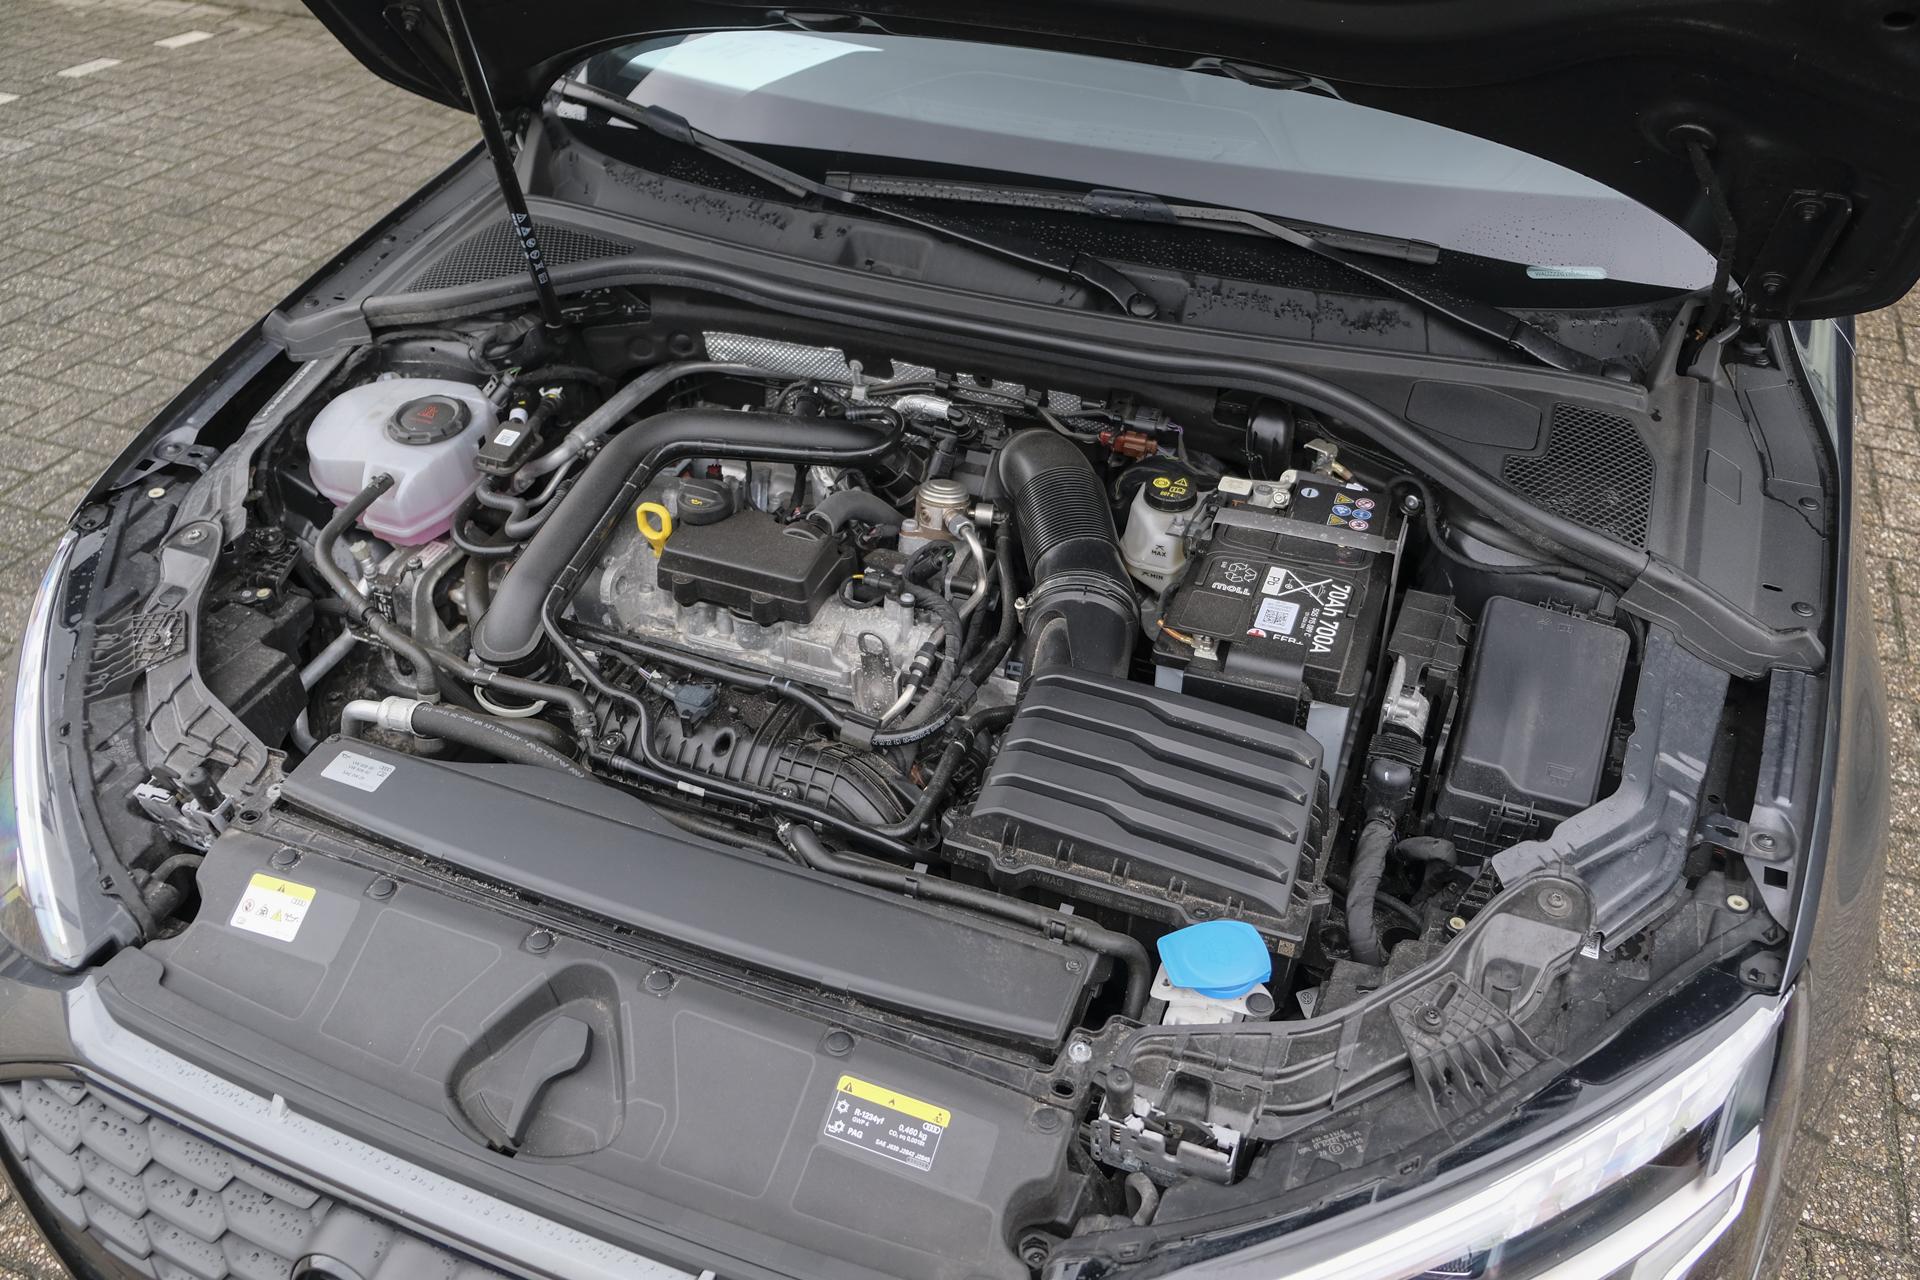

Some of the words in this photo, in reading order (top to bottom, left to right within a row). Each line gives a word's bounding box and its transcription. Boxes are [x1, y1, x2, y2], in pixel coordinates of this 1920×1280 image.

[1151, 549, 1167, 558] MAX
[1149, 572, 1164, 581] MIN
[1267, 575, 1281, 587] Pb
[1322, 584, 1351, 617] 70Ah
[1309, 620, 1340, 653] 700A
[854, 1108, 885, 1125] R-1234yf
[847, 1127, 864, 1139] PAG
[918, 1130, 928, 1141] kg
